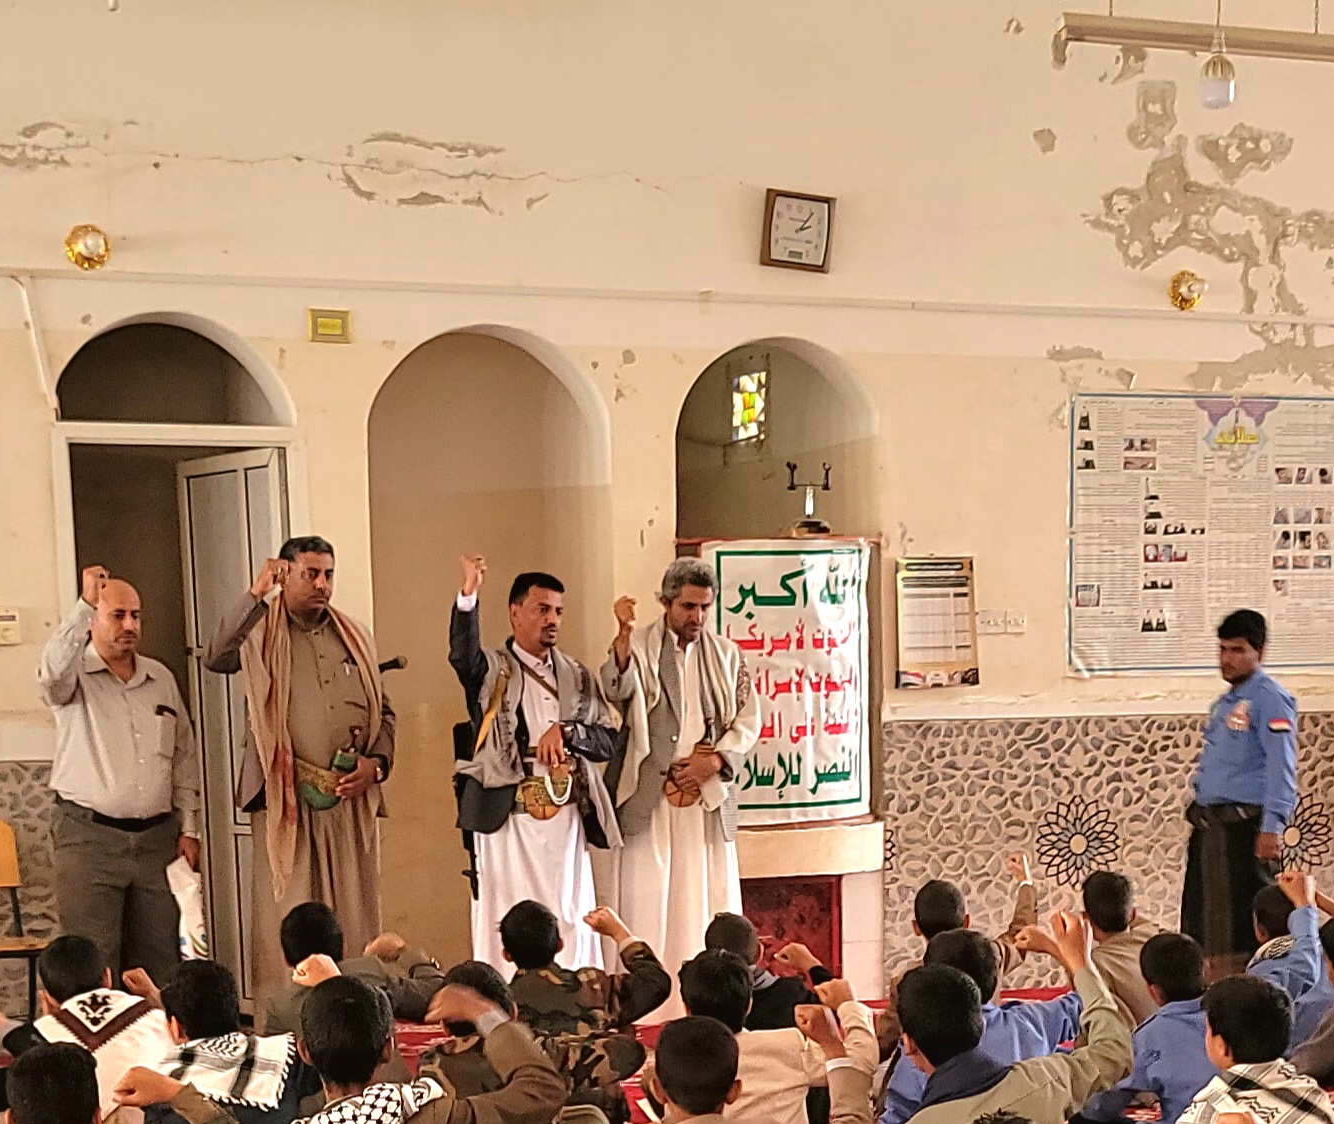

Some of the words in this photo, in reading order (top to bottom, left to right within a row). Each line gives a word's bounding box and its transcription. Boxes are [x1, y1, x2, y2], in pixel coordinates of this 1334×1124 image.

[725, 558, 815, 620] أكبر
[726, 617, 806, 657] لأمريكا
[755, 666, 805, 702] لإسرائ
[758, 710, 783, 745] الي
[808, 745, 858, 796] النصر
